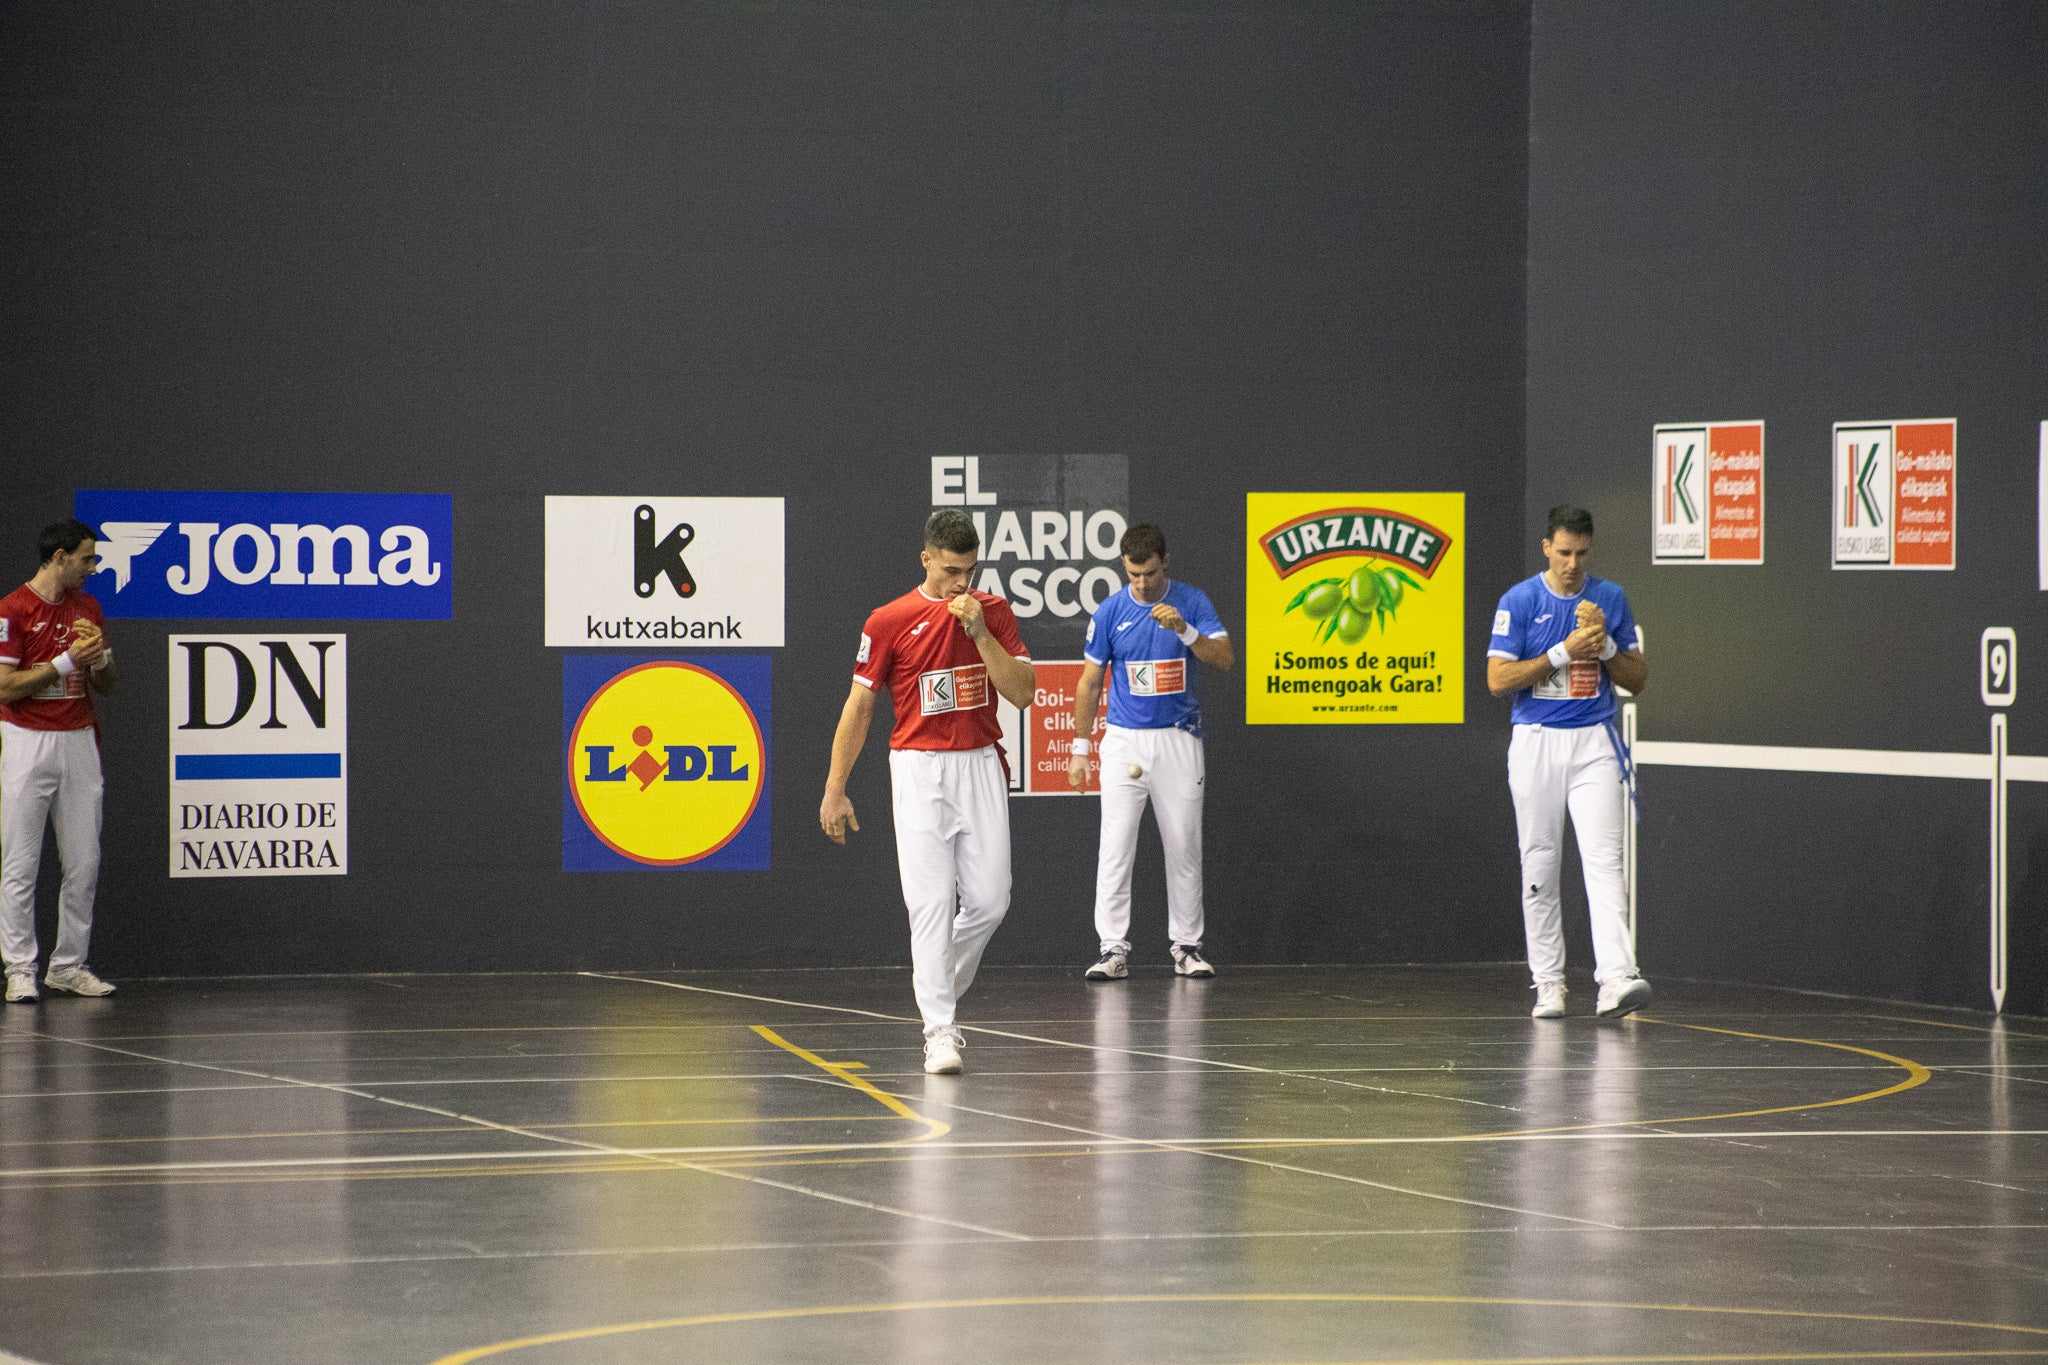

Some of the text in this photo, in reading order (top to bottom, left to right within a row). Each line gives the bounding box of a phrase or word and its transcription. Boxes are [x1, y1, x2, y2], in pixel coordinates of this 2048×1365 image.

[931, 456, 997, 506] EL
[932, 510, 1127, 561] IARIO
[1275, 516, 1435, 565] URZANTE
[966, 566, 1122, 618] ASCO
[587, 615, 742, 640] kutxabank
[1274, 651, 1437, 674] ¡Somos de aquí!
[1991, 645, 2007, 688] 9
[178, 641, 336, 730] DN
[1266, 675, 1443, 697] Hemengoak Gara!
[1312, 703, 1398, 713] www.urzante.com
[181, 803, 337, 830] DIARIO DE
[181, 839, 339, 870] NAVARRA
